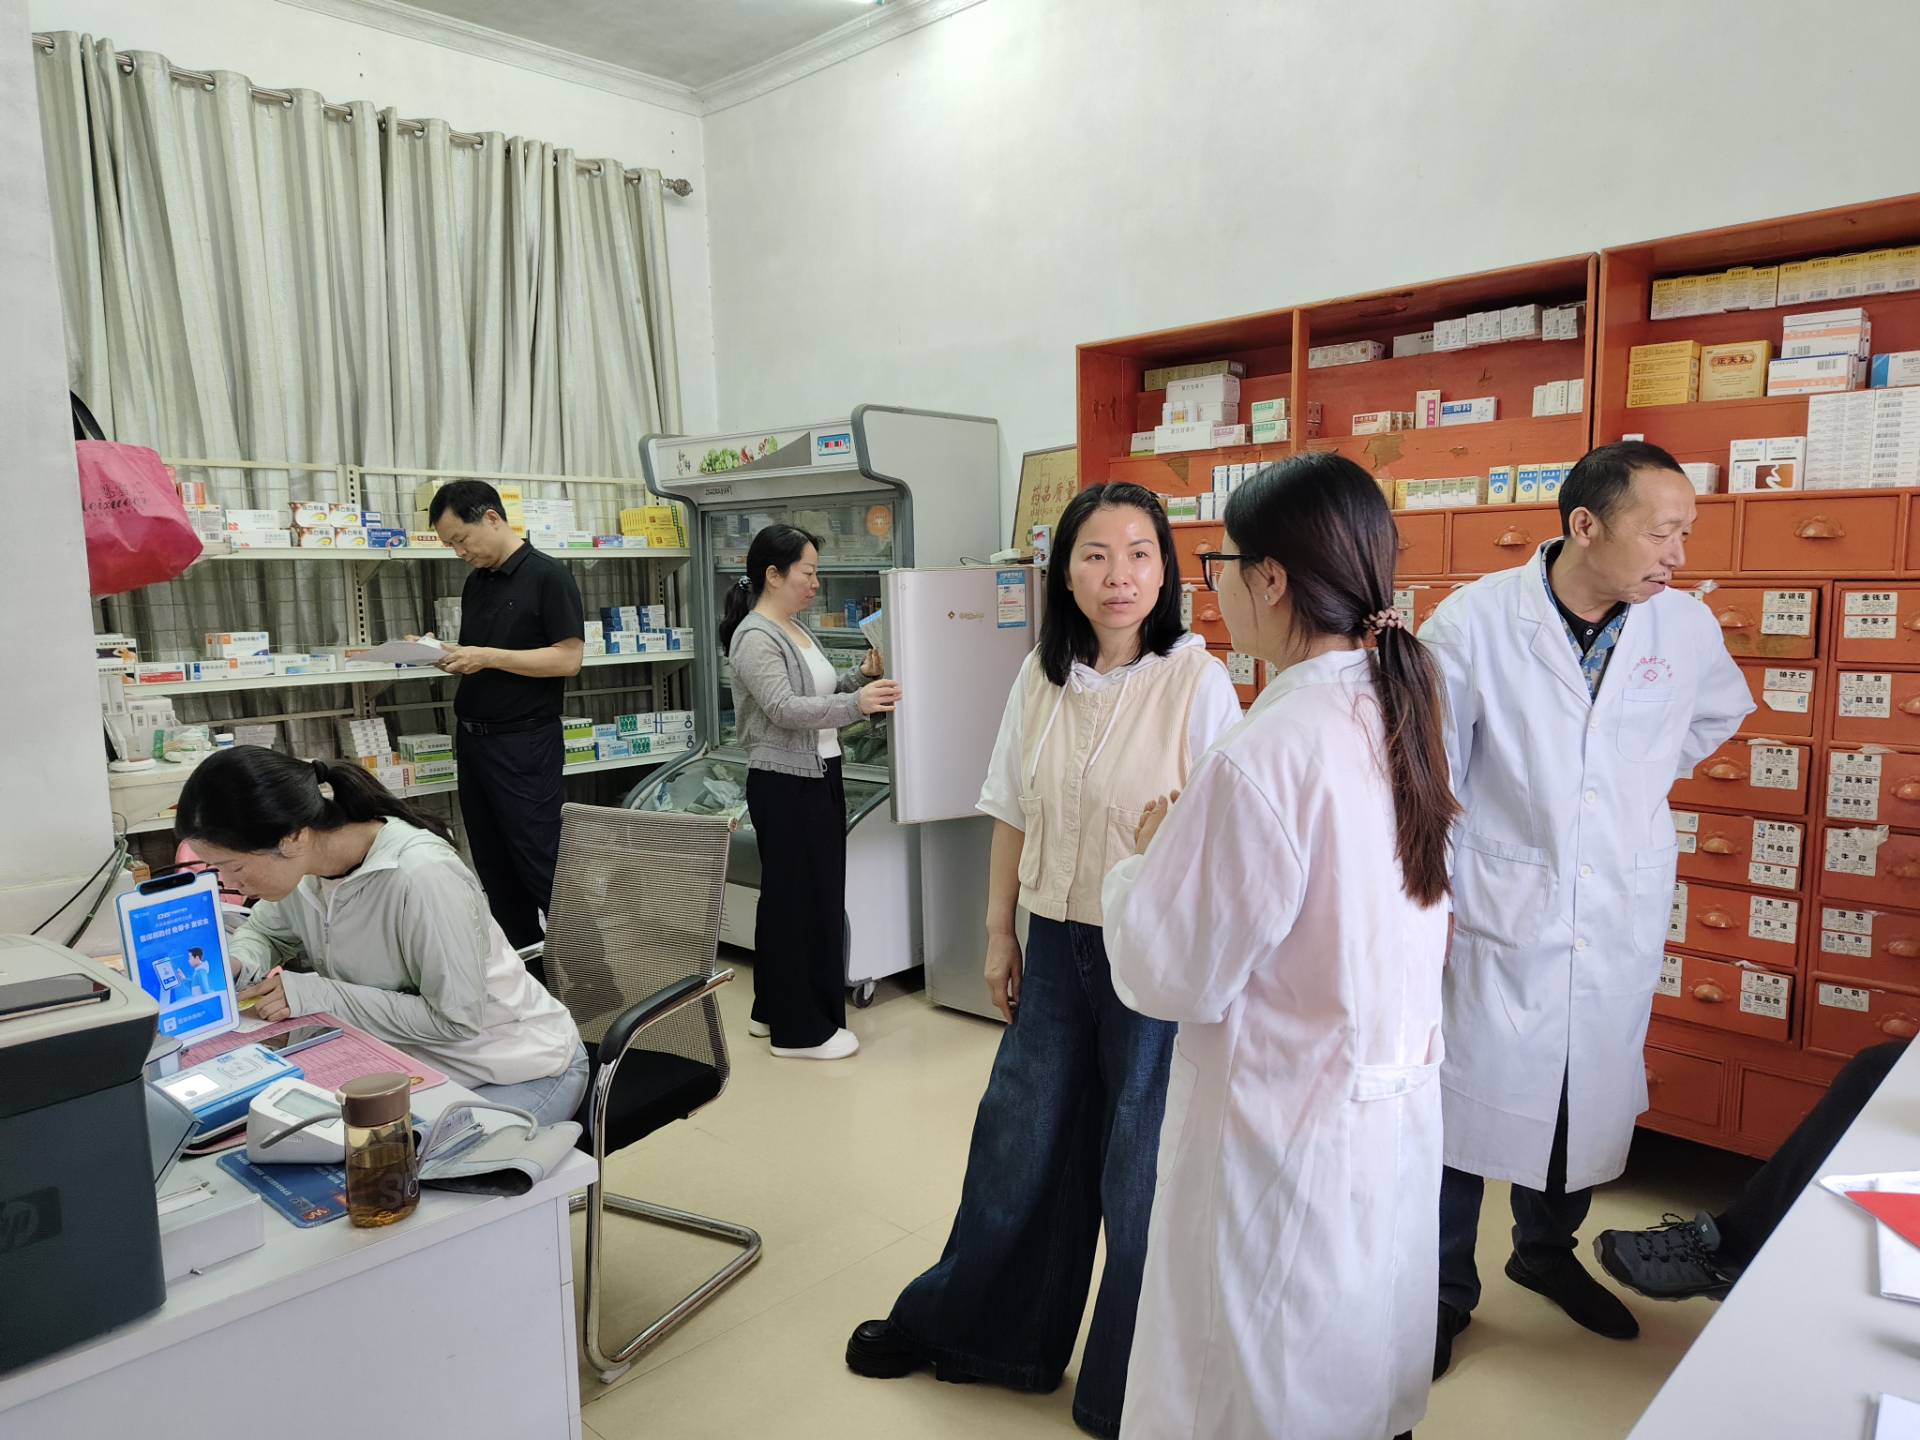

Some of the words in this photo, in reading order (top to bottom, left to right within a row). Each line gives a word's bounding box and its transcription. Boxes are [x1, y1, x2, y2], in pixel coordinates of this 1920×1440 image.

[1778, 592, 1805, 600] 金银花
[1861, 593, 1891, 601] 金钱草
[1766, 747, 1793, 756] 鸡内金
